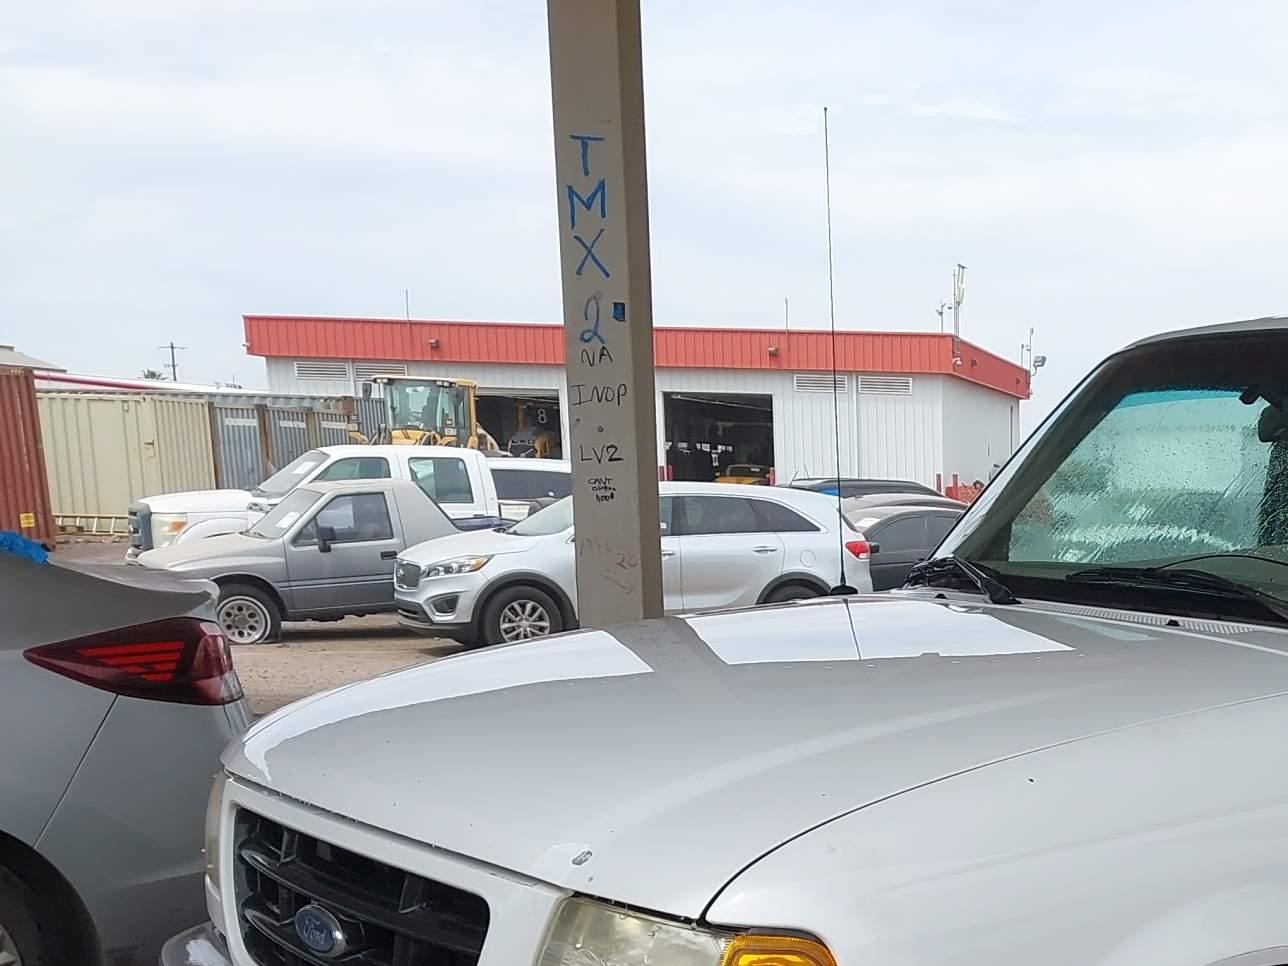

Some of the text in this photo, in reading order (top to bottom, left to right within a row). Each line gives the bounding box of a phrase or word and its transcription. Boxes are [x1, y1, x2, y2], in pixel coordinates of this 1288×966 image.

[581, 346, 613, 367] NA
[571, 383, 627, 406] INOP
[538, 409, 547, 424] 8
[579, 444, 624, 464] LV2
[303, 916, 327, 945] Ford
